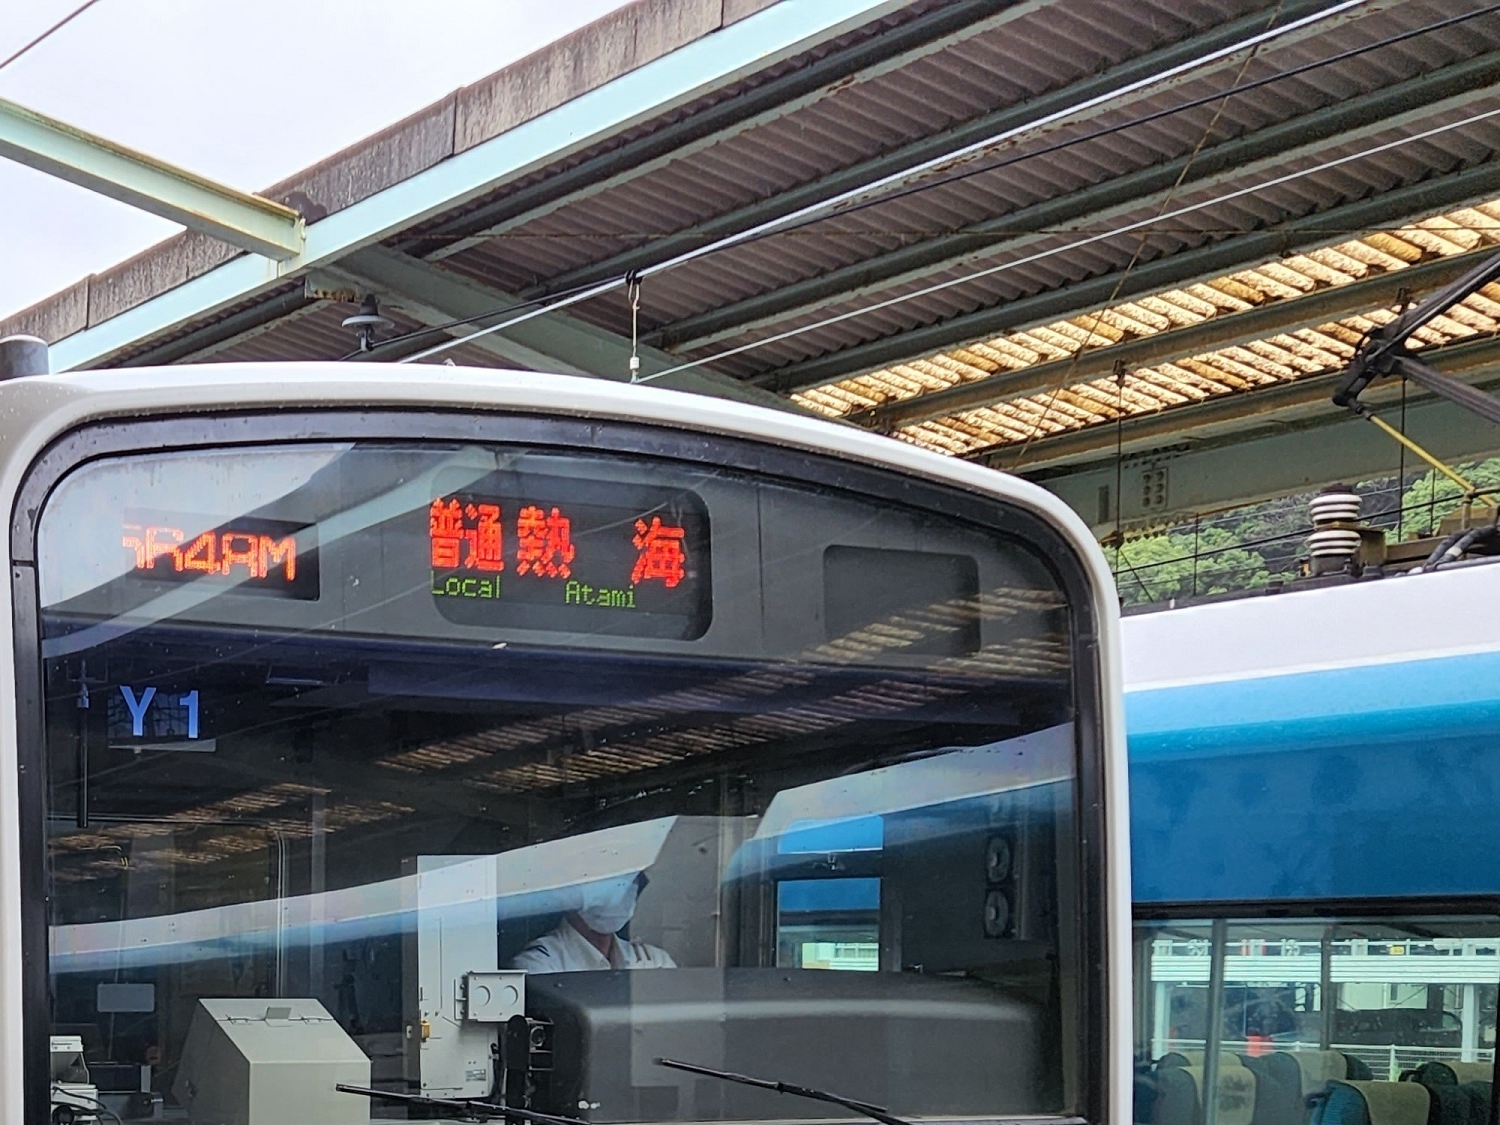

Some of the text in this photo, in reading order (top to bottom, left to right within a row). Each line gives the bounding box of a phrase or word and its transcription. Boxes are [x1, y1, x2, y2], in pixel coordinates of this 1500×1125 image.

[430, 497, 505, 571] 普通
[430, 570, 637, 608] Local Atami
